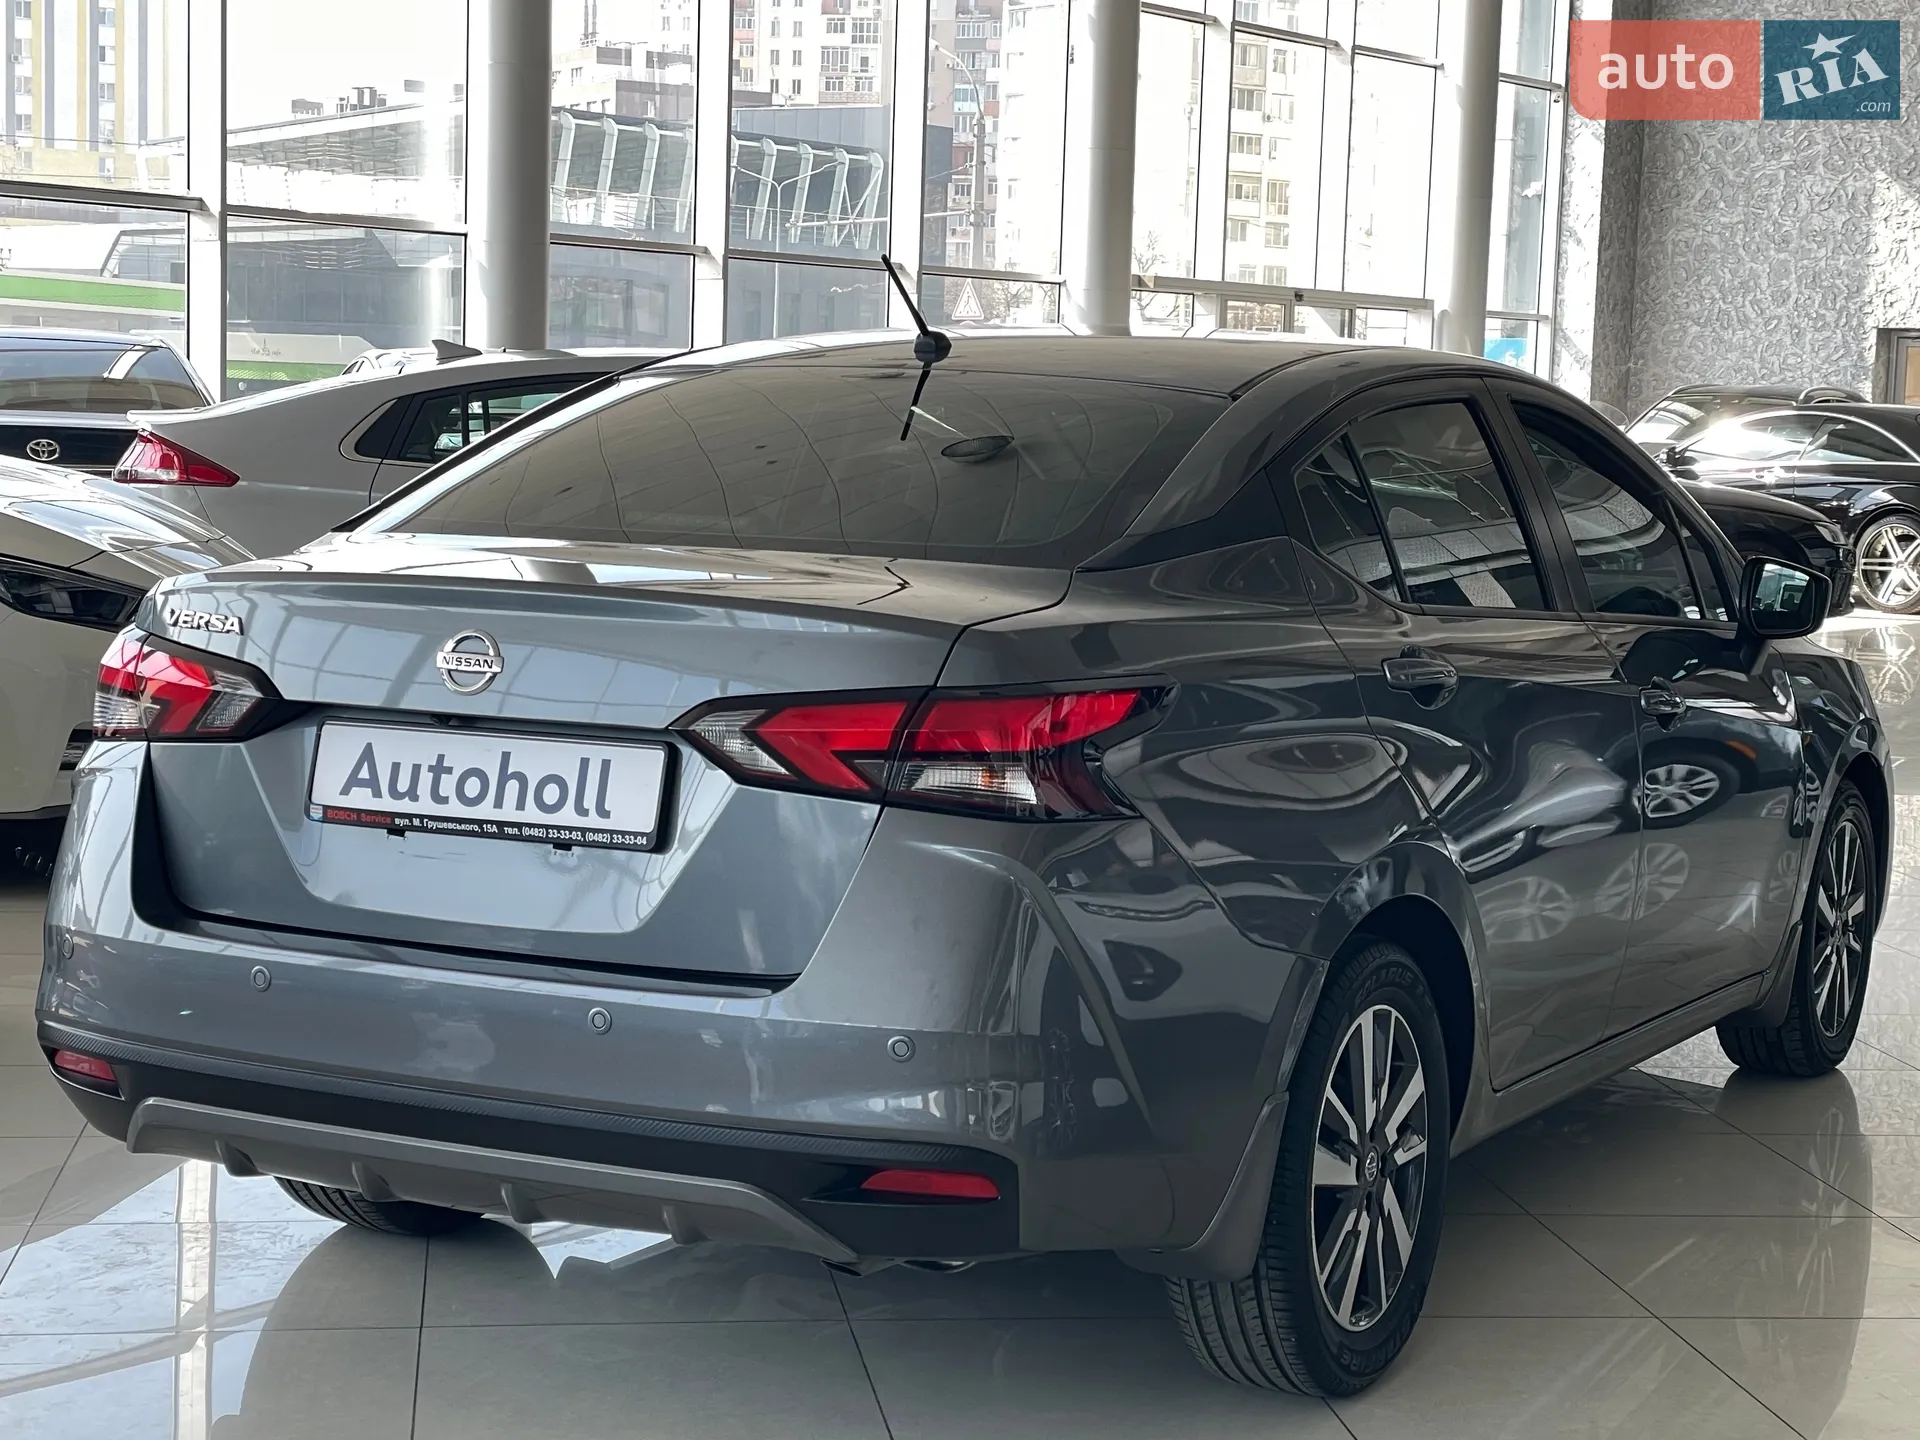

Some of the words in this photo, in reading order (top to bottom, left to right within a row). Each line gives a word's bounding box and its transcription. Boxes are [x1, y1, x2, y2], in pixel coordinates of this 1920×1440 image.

[166, 607, 244, 636] VERSA
[442, 655, 494, 669] NISSAN
[339, 742, 612, 820] Autoholl
[326, 809, 357, 821] BOSCH
[360, 812, 392, 824] Service
[394, 818, 411, 827] вул.
[423, 819, 481, 833] Грушевського,
[504, 827, 520, 836] тел.
[522, 826, 547, 838] (0482)
[547, 829, 584, 842] 33-33-03,
[585, 833, 610, 844] (0482)
[612, 834, 647, 846] 33-33-04
